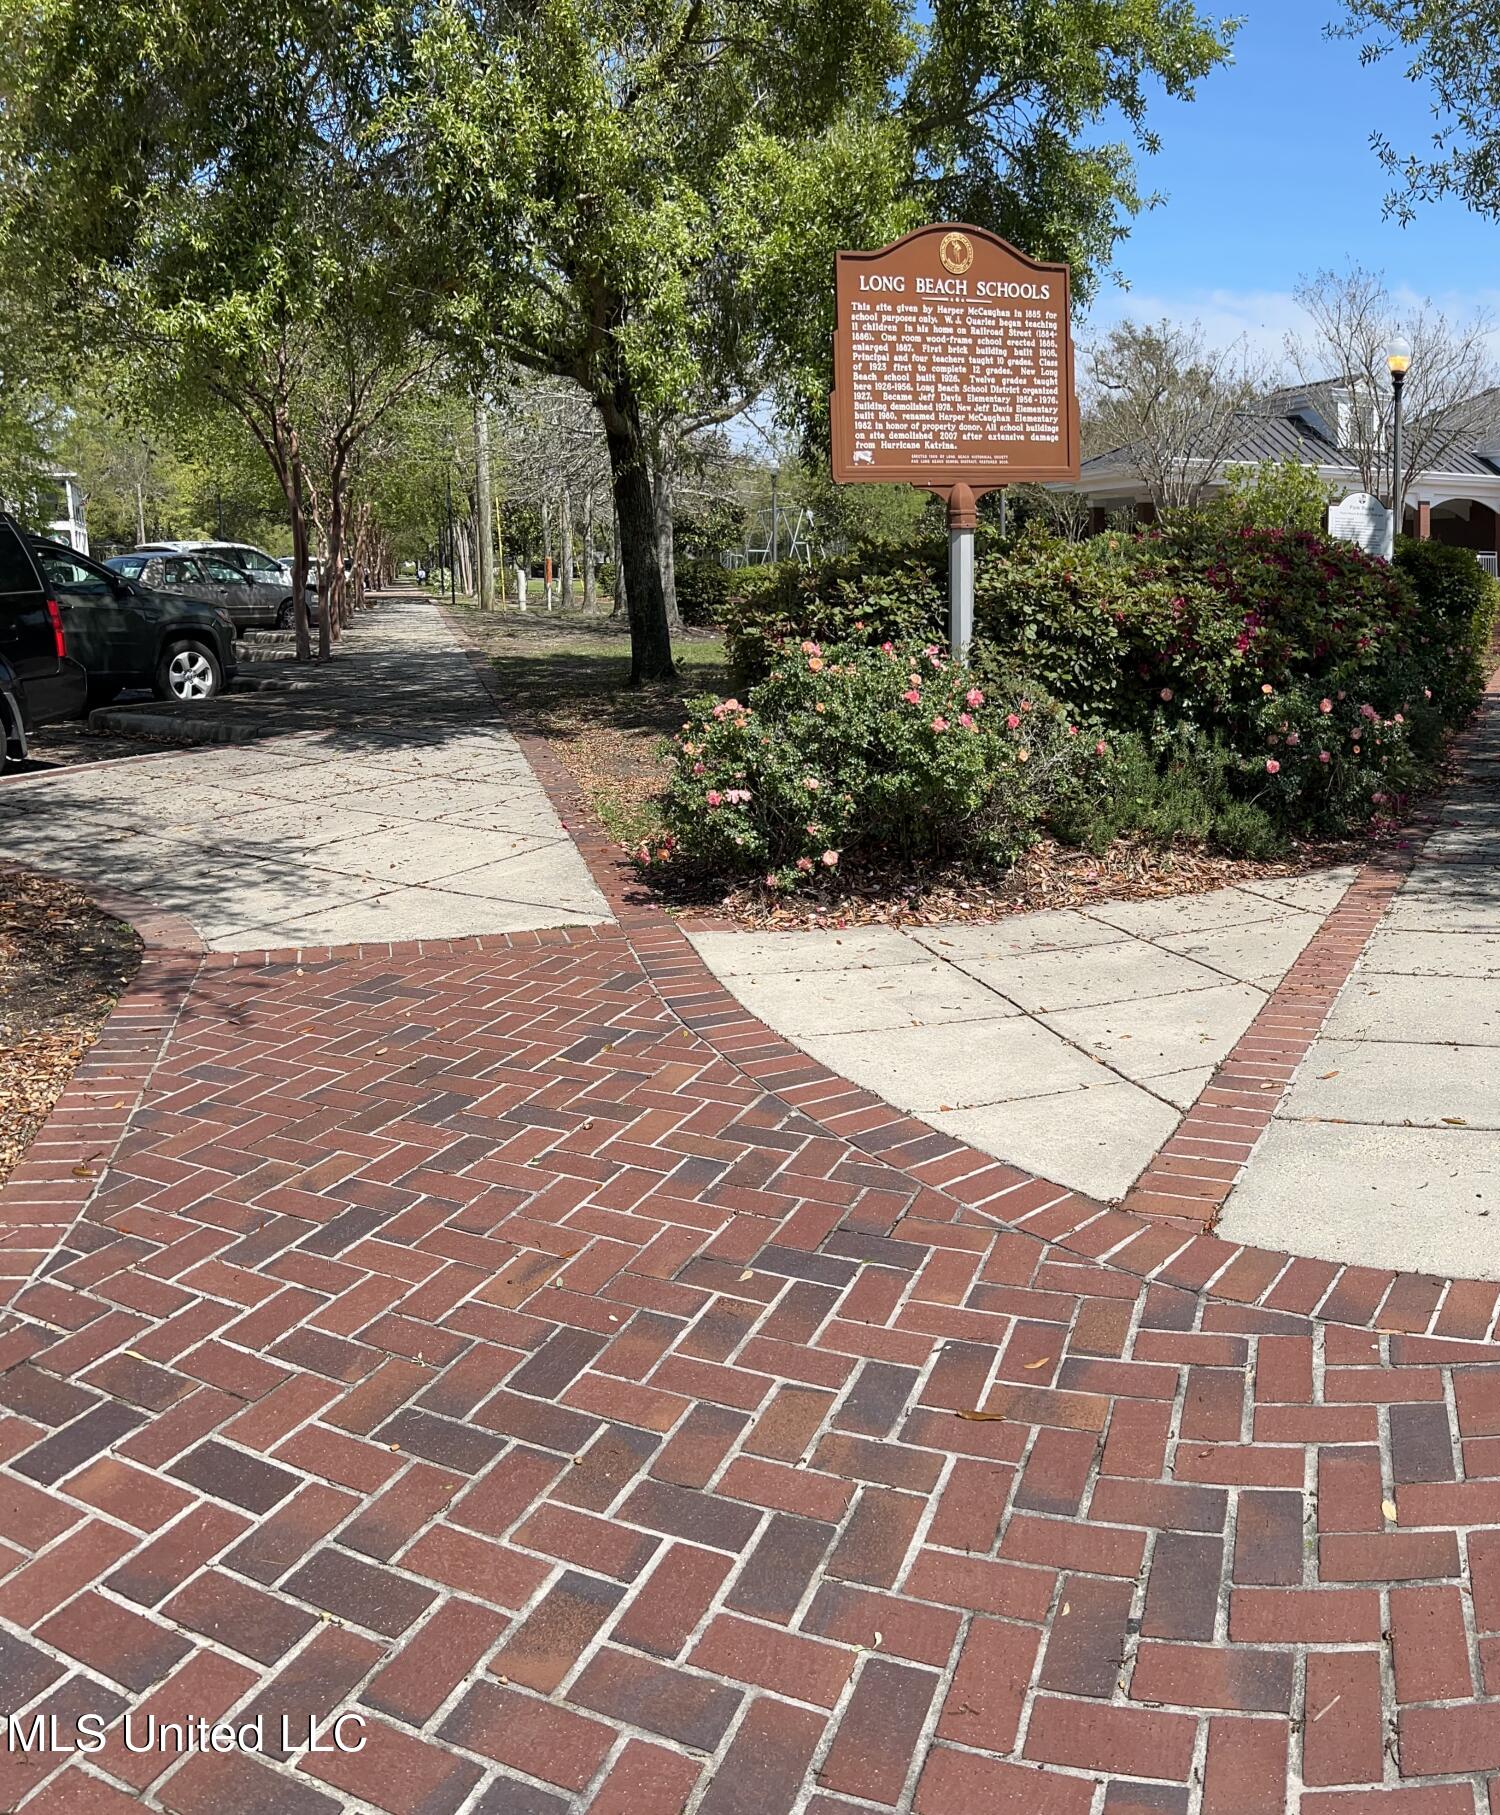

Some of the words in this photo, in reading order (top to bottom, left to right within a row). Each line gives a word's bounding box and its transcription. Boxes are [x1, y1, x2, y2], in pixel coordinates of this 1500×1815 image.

[860, 275, 904, 291] LONG
[916, 278, 967, 295] BEACH
[977, 282, 1049, 299] SCHOOLS
[851, 302, 870, 310] This
[876, 303, 892, 311] site
[897, 304, 918, 313] given
[923, 305, 933, 313] by
[938, 305, 964, 315] Harper
[968, 307, 1010, 317] McCaughan
[1015, 309, 1022, 317] in
[1026, 310, 1041, 318] 1885
[882, 314, 916, 323] purposes
[966, 317, 995, 326] Quarles
[999, 319, 1021, 328] began
[1025, 320, 1057, 330] teaching
[862, 323, 897, 332] children
[905, 324, 912, 332] in
[917, 324, 928, 332] his
[933, 325, 953, 333] home
[971, 327, 1003, 336] Railroad
[1008, 329, 1032, 337] Street
[881, 333, 896, 341] One
[926, 335, 972, 344] wood-frame
[978, 337, 1002, 345] school
[1007, 339, 1035, 347] erected
[852, 343, 888, 352] enlarged
[922, 344, 942, 352] First
[948, 345, 968, 354] brick
[976, 347, 1007, 357] building
[1014, 348, 1032, 356] built
[853, 353, 889, 362] Principal
[894, 354, 908, 362] and
[912, 354, 928, 362] four
[932, 355, 965, 363] teachers
[969, 356, 993, 365] taught
[1007, 358, 1033, 366] grades.
[1039, 359, 1058, 367] Class
[869, 363, 886, 371] 1923
[932, 365, 966, 373] complete
[986, 367, 1012, 375] grades.
[1021, 367, 1035, 375] New
[1041, 368, 1058, 377] Long
[853, 372, 877, 380] Beach
[884, 373, 909, 381] school
[916, 373, 935, 381] built
[969, 375, 995, 383] Twelve
[1002, 376, 1027, 385] grades
[1033, 377, 1058, 386] taught
[854, 382, 872, 390] here
[916, 383, 935, 392] Long
[938, 384, 959, 392] Beach
[963, 385, 987, 393] School
[990, 385, 1019, 393] District
[1023, 387, 1058, 396] organized
[919, 393, 935, 401] Jeff
[941, 393, 961, 401] Davis
[967, 394, 1010, 403] Elementary
[854, 402, 887, 411] Building
[890, 402, 933, 411] demolished
[957, 403, 971, 411] New
[974, 404, 990, 412] Jeff
[993, 404, 1012, 412] Davis
[1016, 405, 1058, 414] Elementary
[854, 412, 874, 420] built
[939, 413, 965, 422] Harper
[969, 413, 1010, 422] McCaughan
[1015, 414, 1058, 424] Elementary
[911, 422, 920, 430] of
[922, 423, 956, 431] property
[959, 423, 982, 431] donor.
[1026, 424, 1058, 433] buildings
[889, 431, 932, 440] demolished
[940, 432, 957, 440] 2007
[1031, 433, 1058, 442] damage
[856, 441, 875, 449] from
[881, 441, 920, 449] Hurricane
[925, 441, 957, 449] Katrina.
